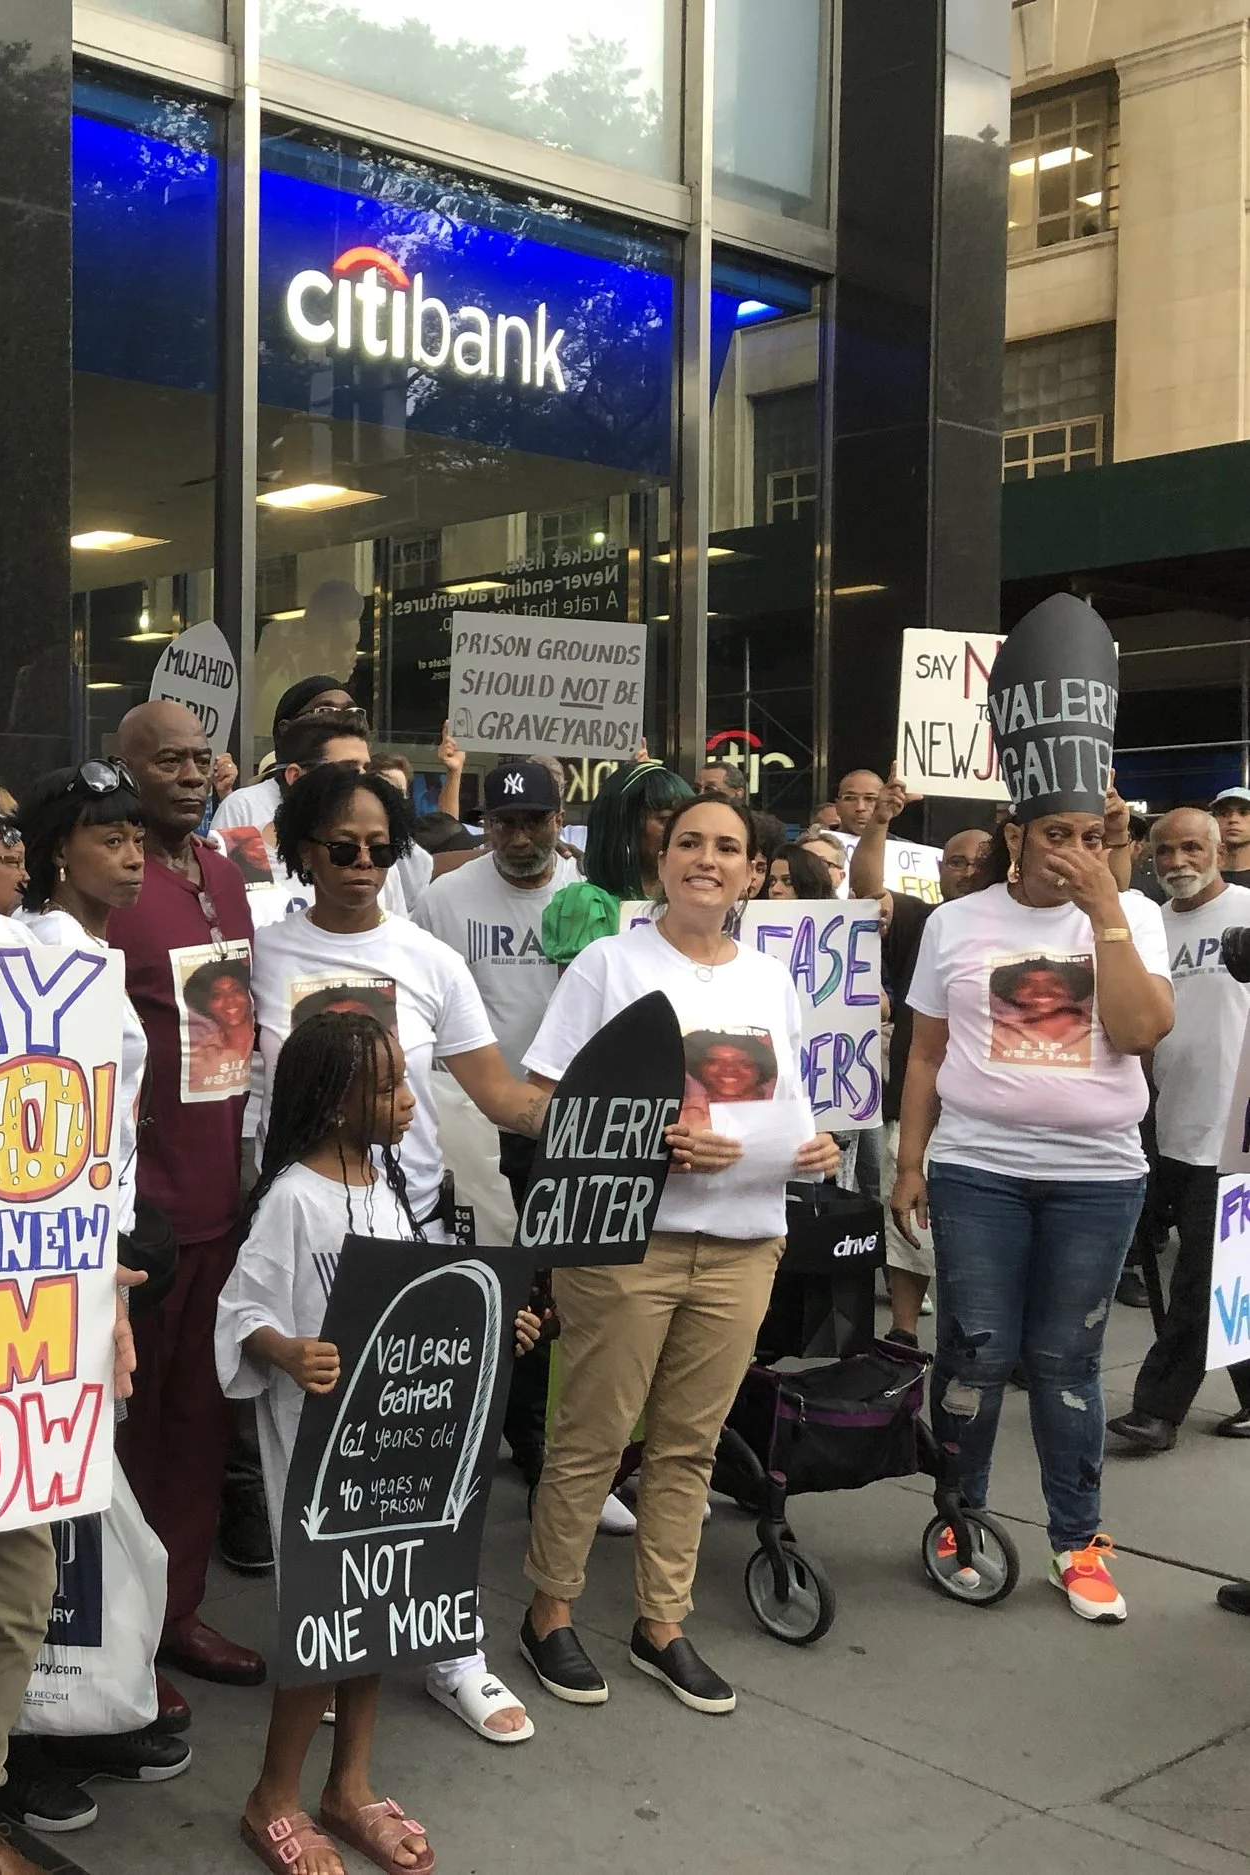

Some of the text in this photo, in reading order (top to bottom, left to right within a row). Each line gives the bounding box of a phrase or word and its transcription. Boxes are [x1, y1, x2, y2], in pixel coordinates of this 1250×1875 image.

[286, 266, 566, 392] citibank
[163, 646, 234, 690] MUJAHID
[455, 632, 641, 666] PRISON GROUNDS
[916, 654, 958, 680] SAY
[460, 669, 640, 705] SHOULD NOT BE
[477, 711, 639, 752] GRAVEYARDS!
[904, 721, 979, 780] NEW
[898, 850, 922, 872] OF
[545, 1096, 678, 1161] VALERIE
[520, 1175, 654, 1248] GAITER
[340, 1420, 368, 1458] 61
[431, 1422, 456, 1449] old
[340, 1478, 364, 1512] 40
[419, 1476, 433, 1493] IN
[342, 1539, 425, 1605] NOT
[296, 1589, 476, 1671] ONE MORE
